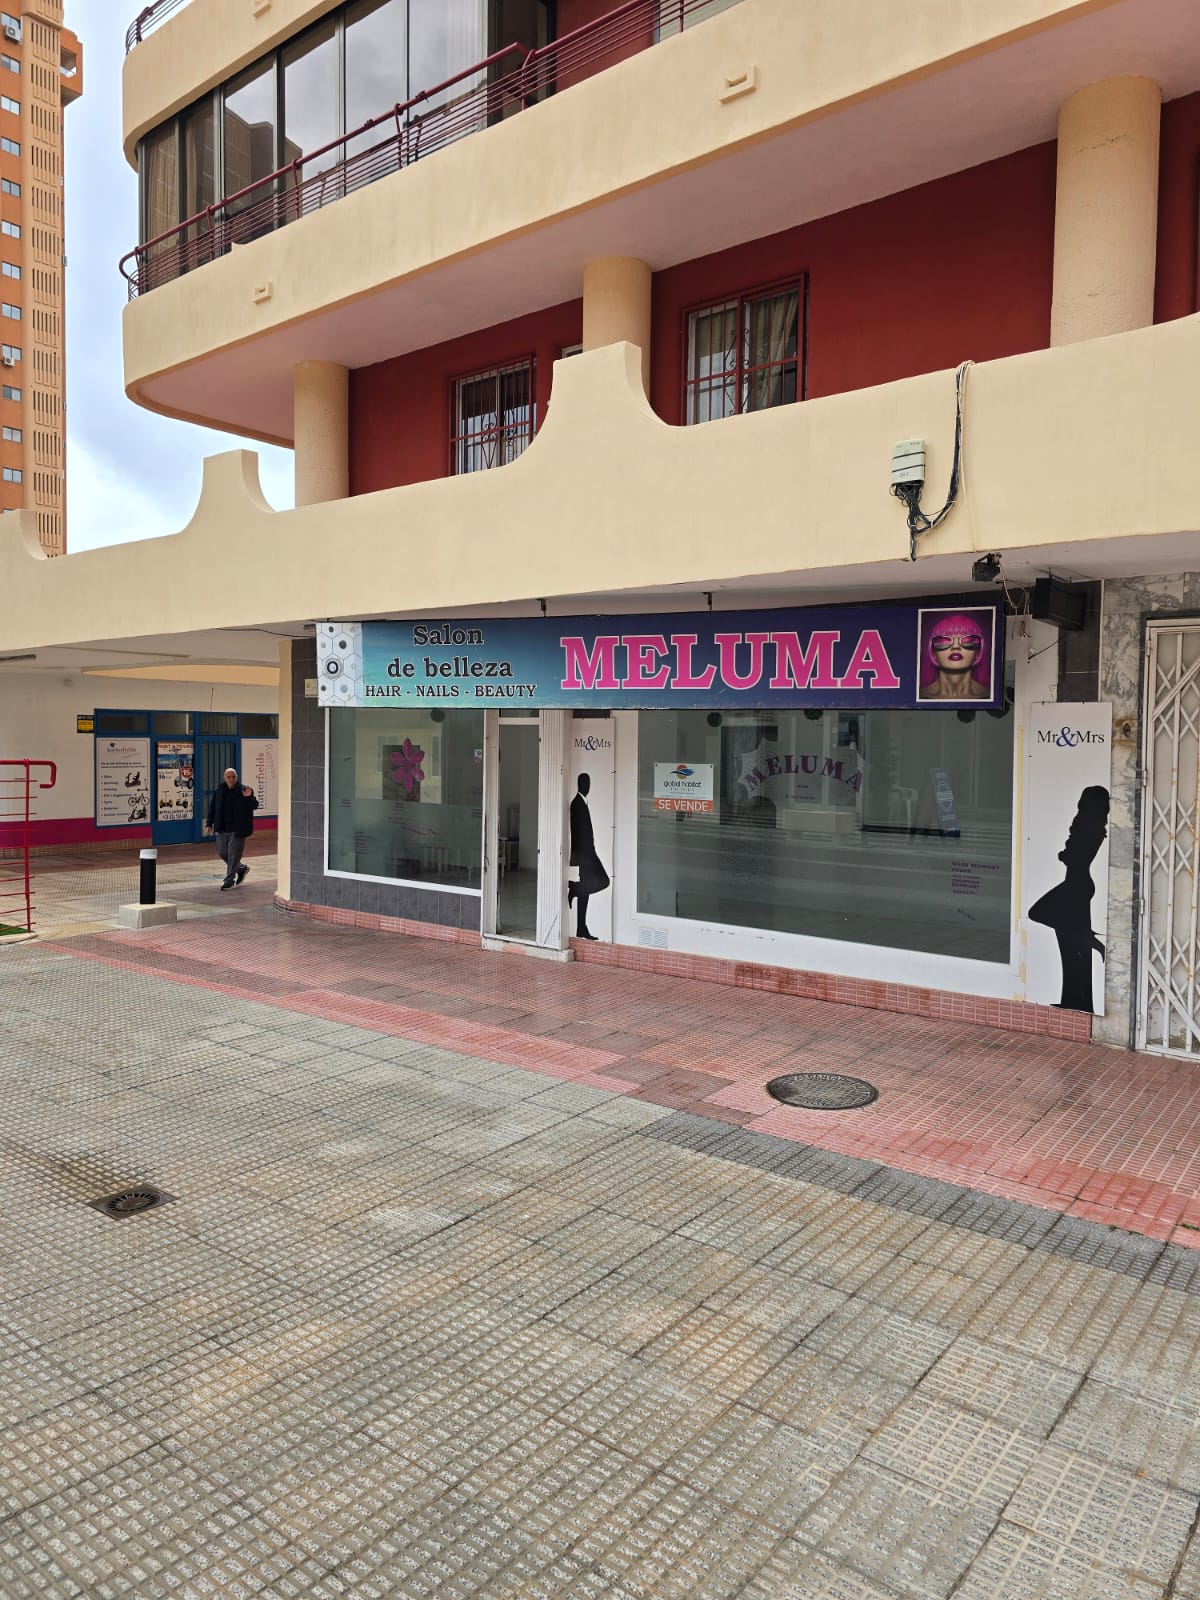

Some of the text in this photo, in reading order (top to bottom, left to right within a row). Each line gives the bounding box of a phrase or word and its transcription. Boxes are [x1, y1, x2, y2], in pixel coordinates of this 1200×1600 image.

[412, 624, 484, 646] Salon
[387, 656, 513, 678] de belleza
[560, 630, 900, 689] MELUMA
[365, 685, 401, 697] HAIR
[416, 685, 459, 697] NAILS
[475, 685, 536, 697] BEAUTY
[574, 735, 612, 751] Mr&Mrs
[1037, 726, 1105, 747] Mr&Mrs
[743, 755, 863, 792] MELUMA
[658, 799, 709, 812] SE VENDE
